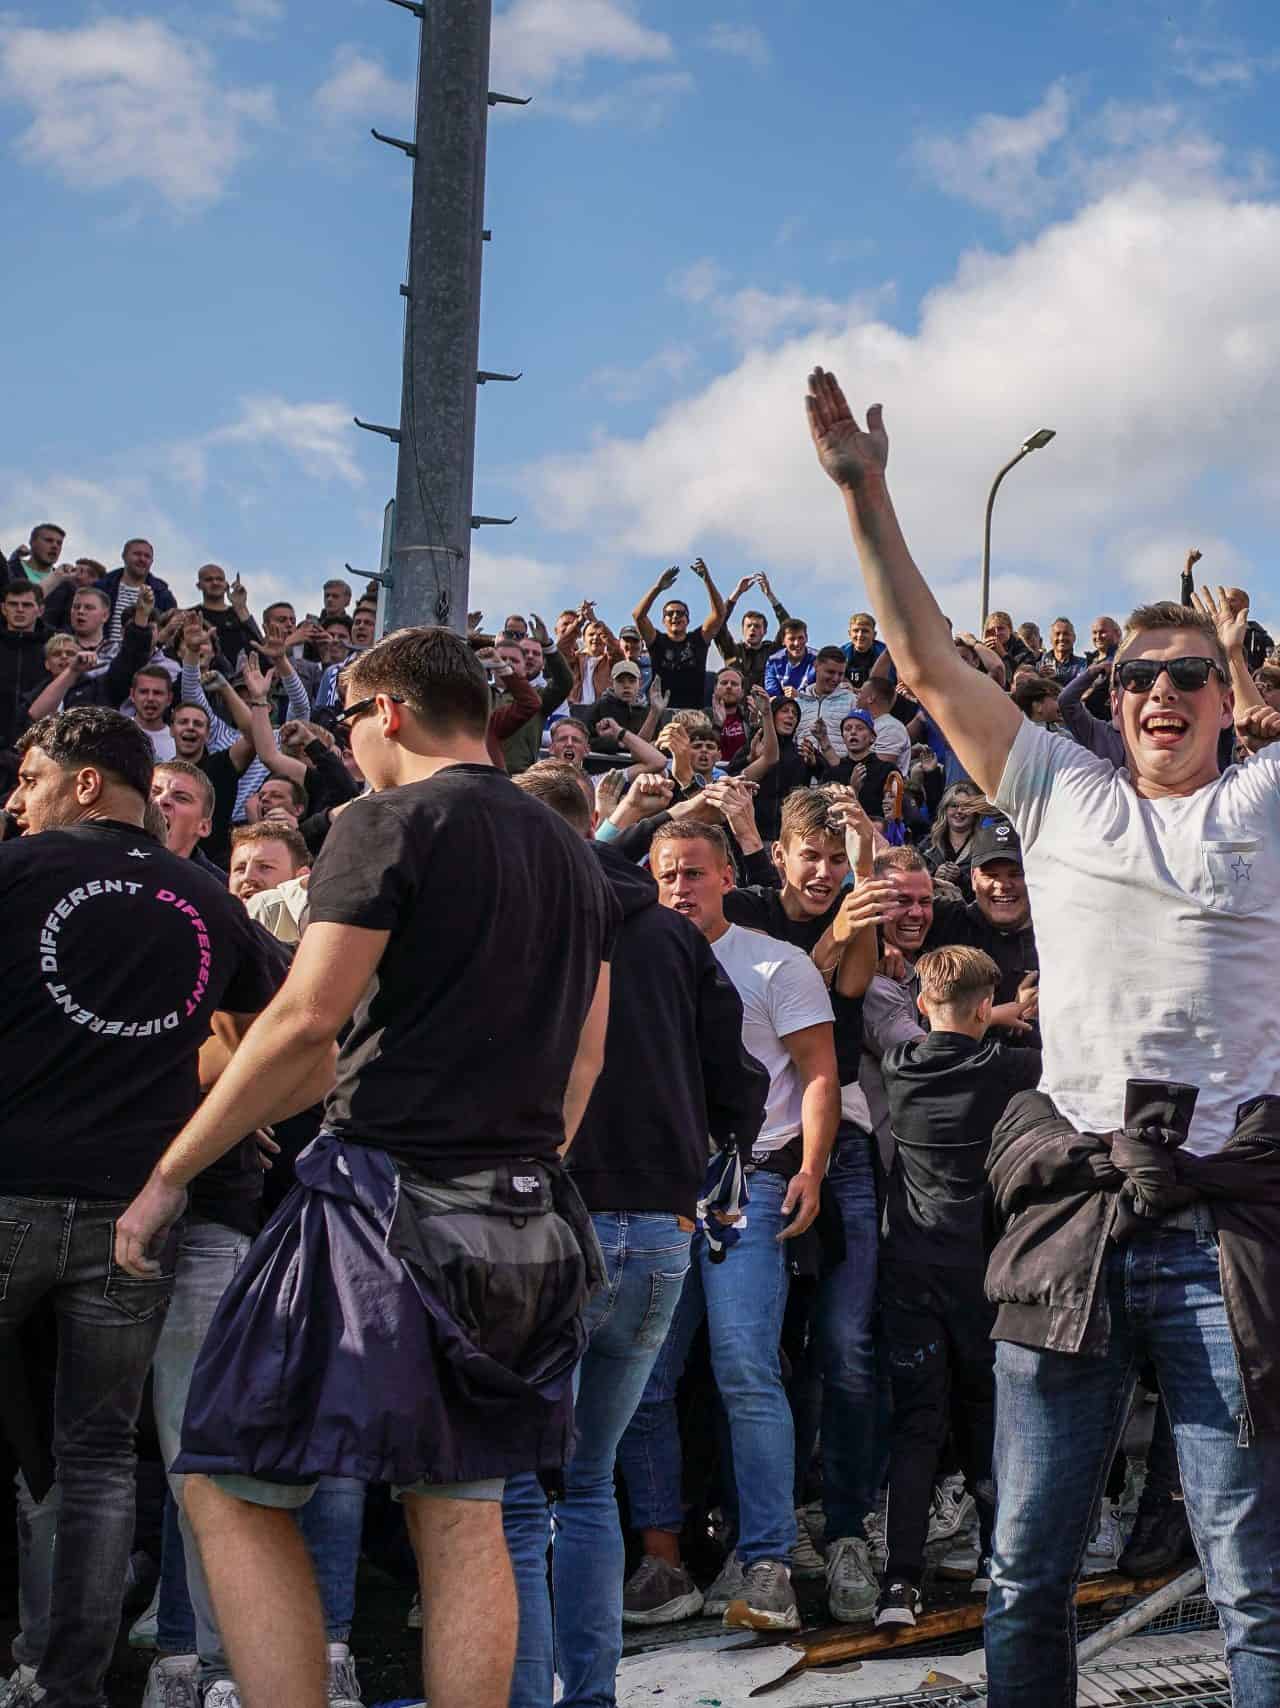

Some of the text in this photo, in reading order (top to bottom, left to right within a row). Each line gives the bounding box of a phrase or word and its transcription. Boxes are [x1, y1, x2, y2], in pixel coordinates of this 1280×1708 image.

[40, 879, 143, 973] DIFFERENT
[154, 888, 213, 1017] DIFFERENT
[45, 981, 180, 1037] DIFFERENT
